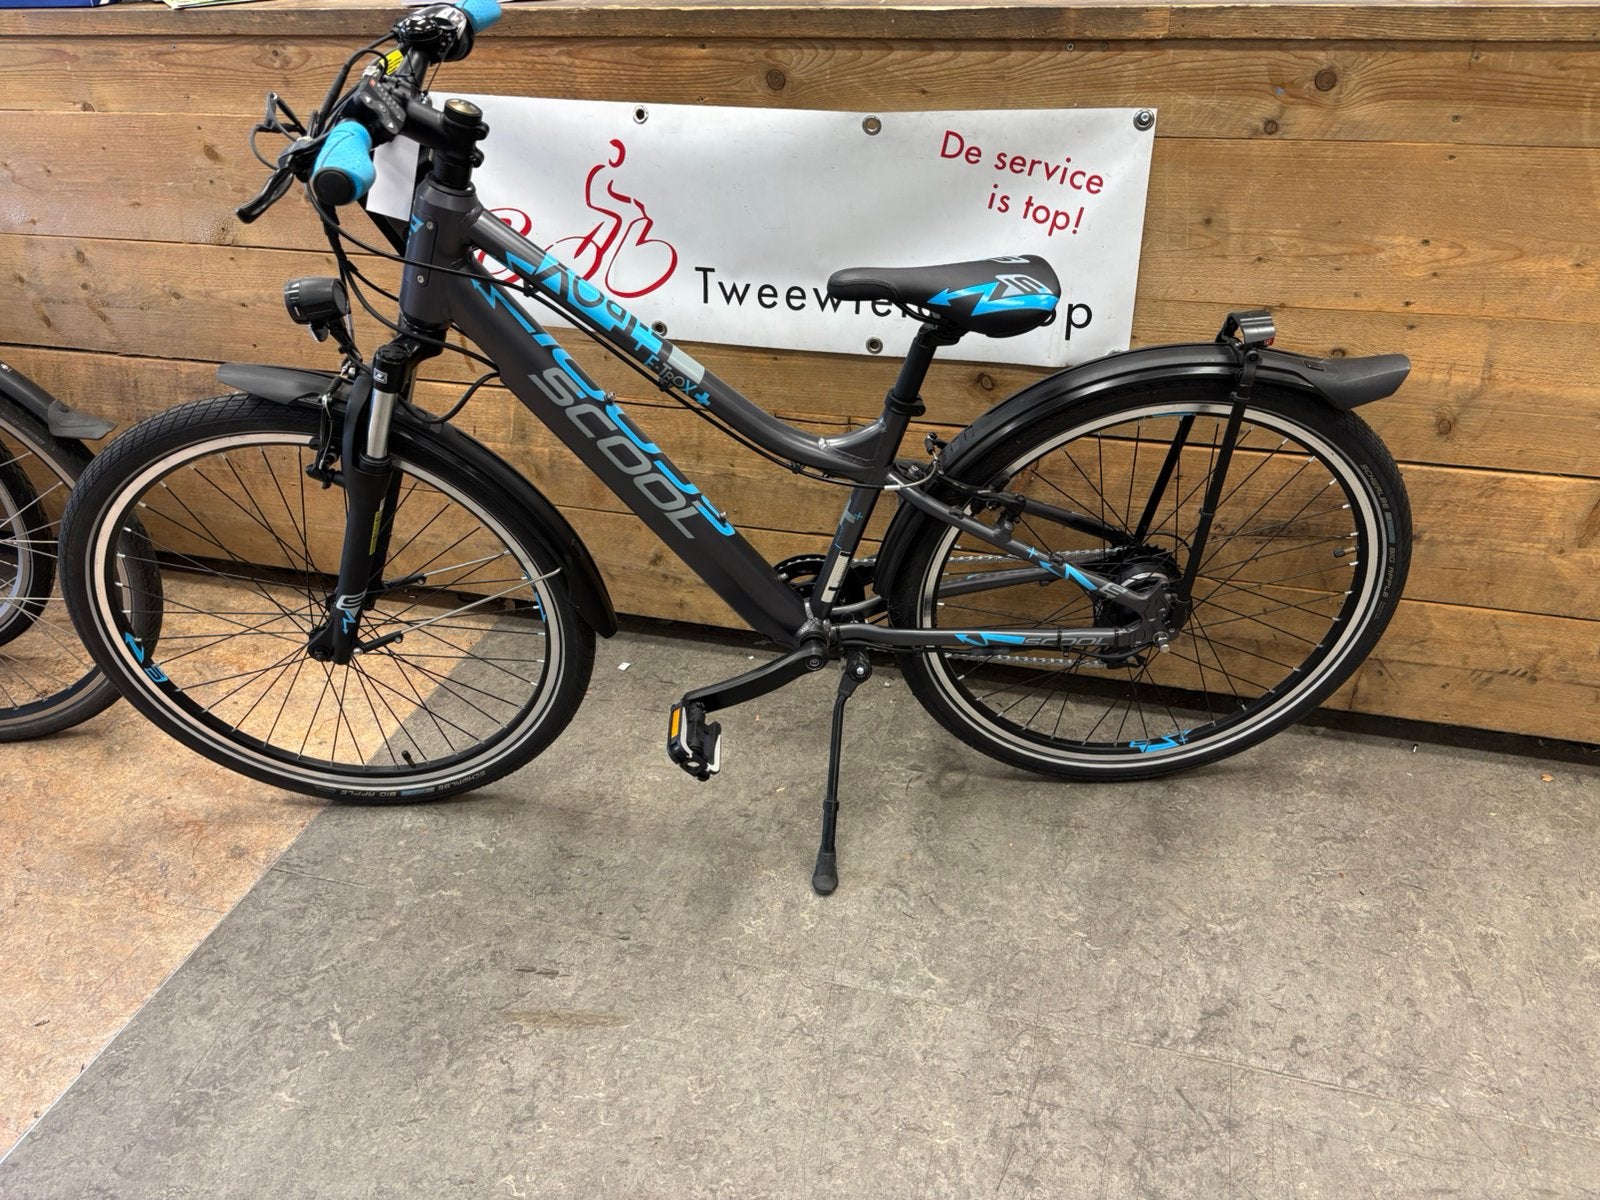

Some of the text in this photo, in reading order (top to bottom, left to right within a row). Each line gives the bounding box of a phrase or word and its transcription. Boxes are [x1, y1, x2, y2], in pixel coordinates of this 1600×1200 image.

[940, 130, 1104, 195] De service
[987, 184, 1085, 237] is top!
[527, 367, 700, 540] SCOOL
